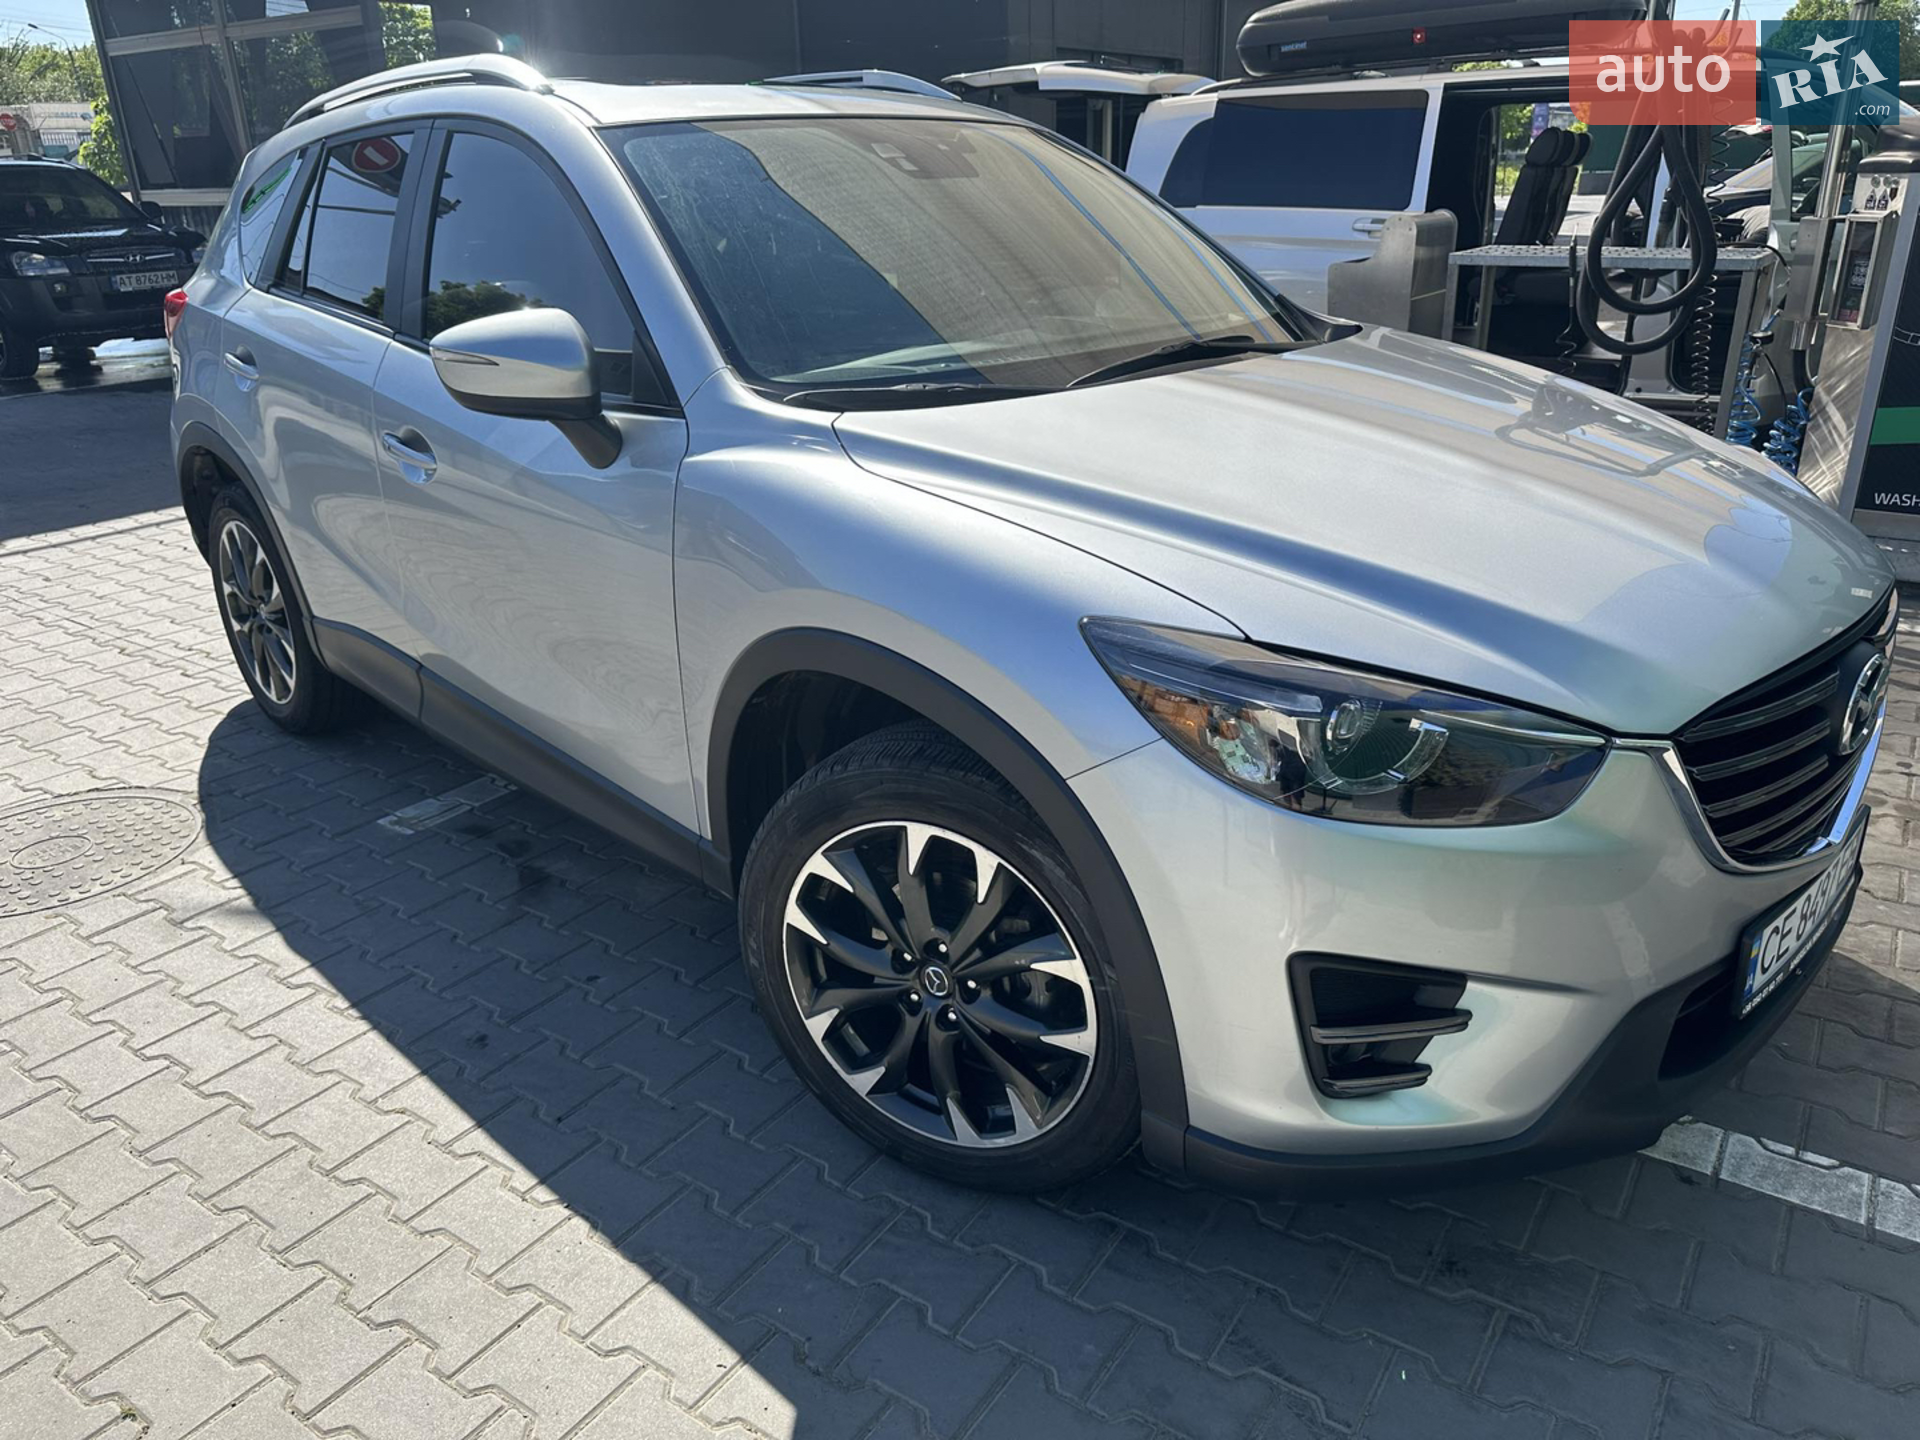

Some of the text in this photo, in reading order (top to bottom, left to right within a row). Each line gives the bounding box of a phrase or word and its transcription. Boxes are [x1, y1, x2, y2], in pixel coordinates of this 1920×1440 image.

[120, 275, 133, 287] AT
[135, 273, 160, 286] 8762
[1874, 492, 1920, 507] WASH
[1761, 906, 1797, 975] CE
[1796, 857, 1840, 942] 8497
